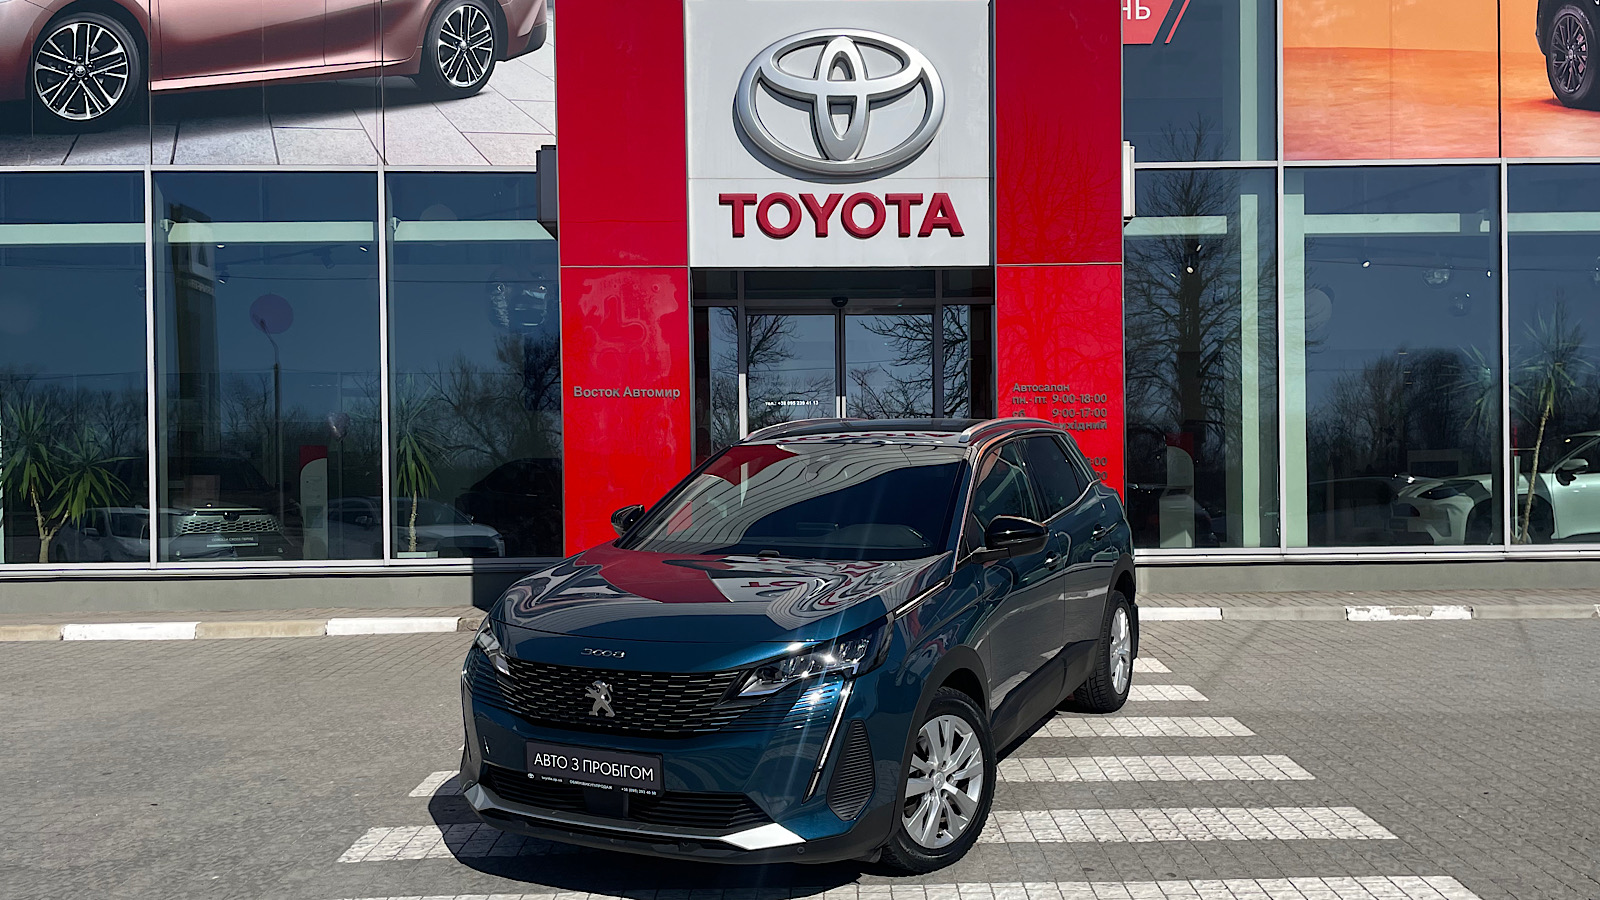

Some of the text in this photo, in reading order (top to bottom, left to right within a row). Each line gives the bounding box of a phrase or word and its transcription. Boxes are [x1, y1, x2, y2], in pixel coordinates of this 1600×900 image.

[718, 191, 965, 240] TOYOTA
[573, 385, 681, 401] Восток Автомир
[1012, 383, 1070, 393] Автосалон
[1052, 393, 1108, 404] 9:00-18:00
[1052, 408, 1108, 418] 9:00-17:00
[533, 752, 568, 769] АВТО
[583, 759, 654, 782] ПРОБІГОМ
